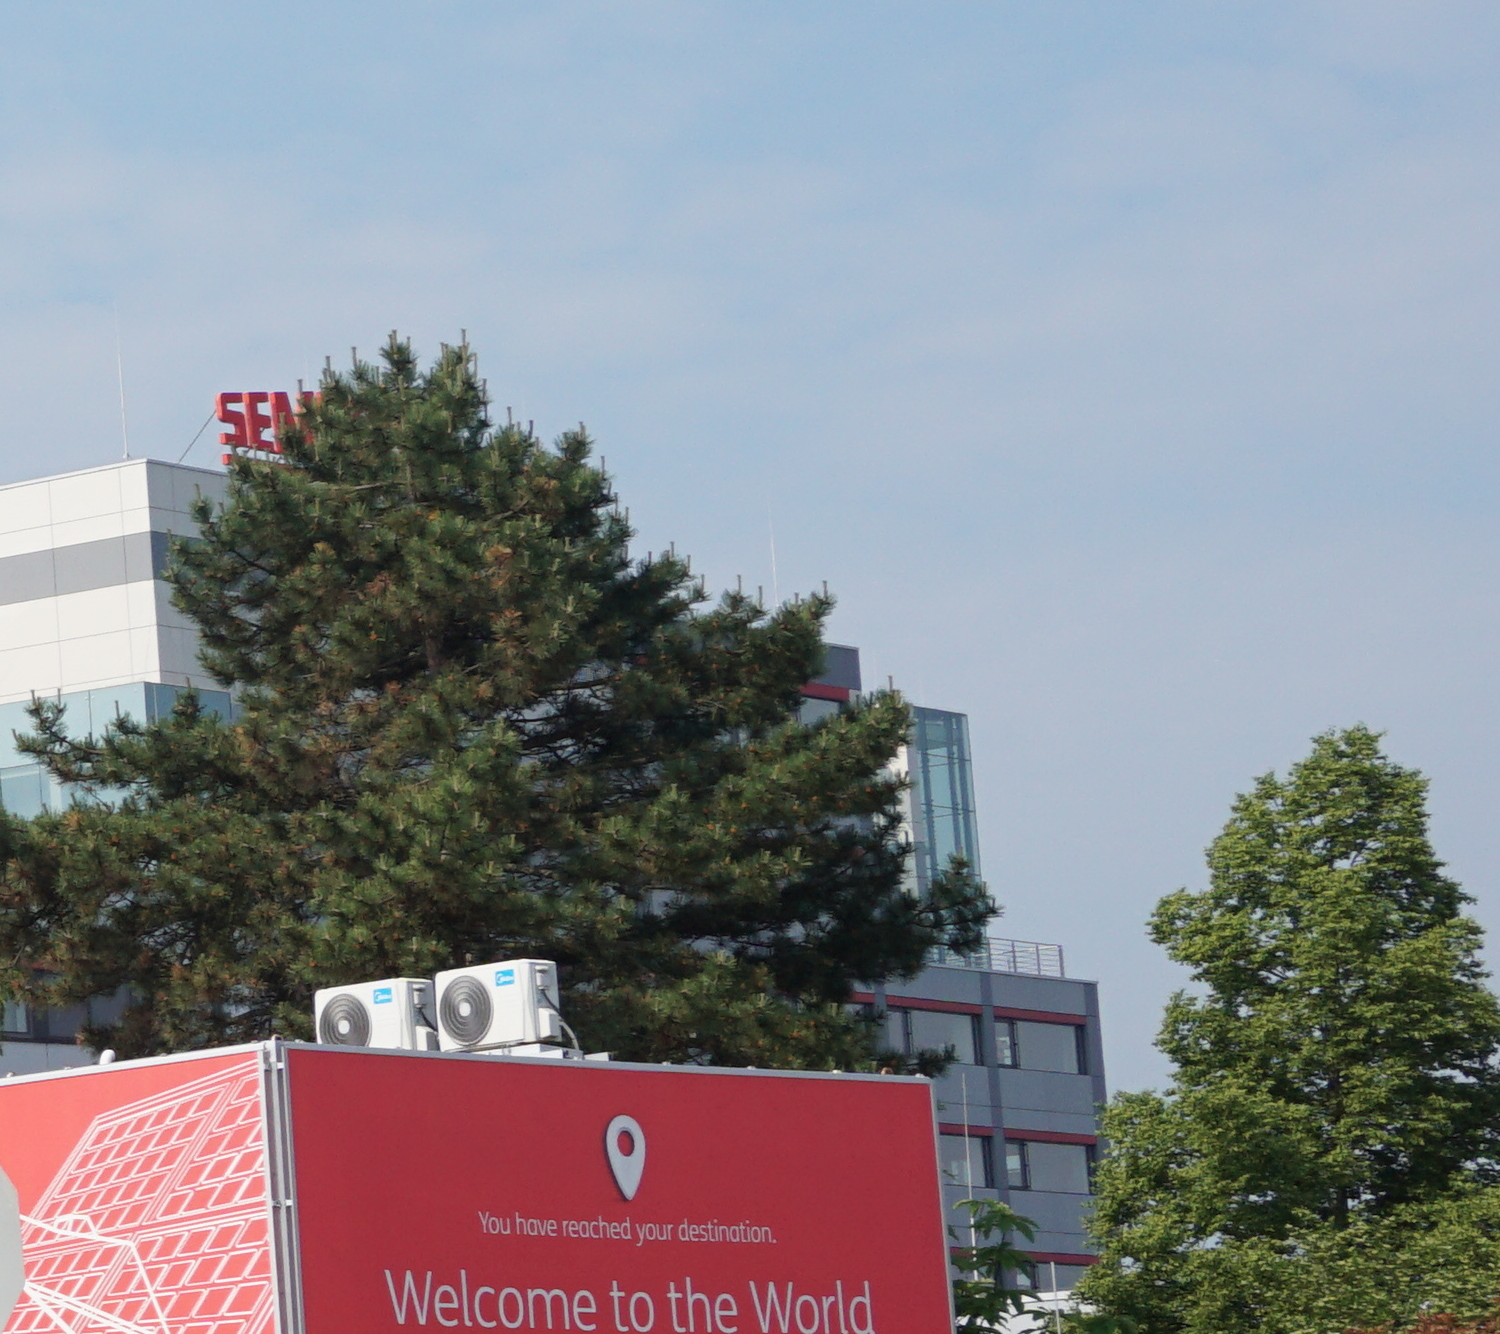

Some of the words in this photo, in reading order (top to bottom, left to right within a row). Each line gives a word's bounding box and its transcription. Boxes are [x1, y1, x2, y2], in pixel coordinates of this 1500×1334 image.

[478, 1210, 511, 1235] You
[514, 1212, 558, 1237] have
[562, 1215, 631, 1240] reached
[635, 1221, 674, 1247] your
[678, 1218, 777, 1244] destination.
[384, 1268, 597, 1332] Welcome
[609, 1279, 655, 1334] to
[666, 1276, 739, 1334] the
